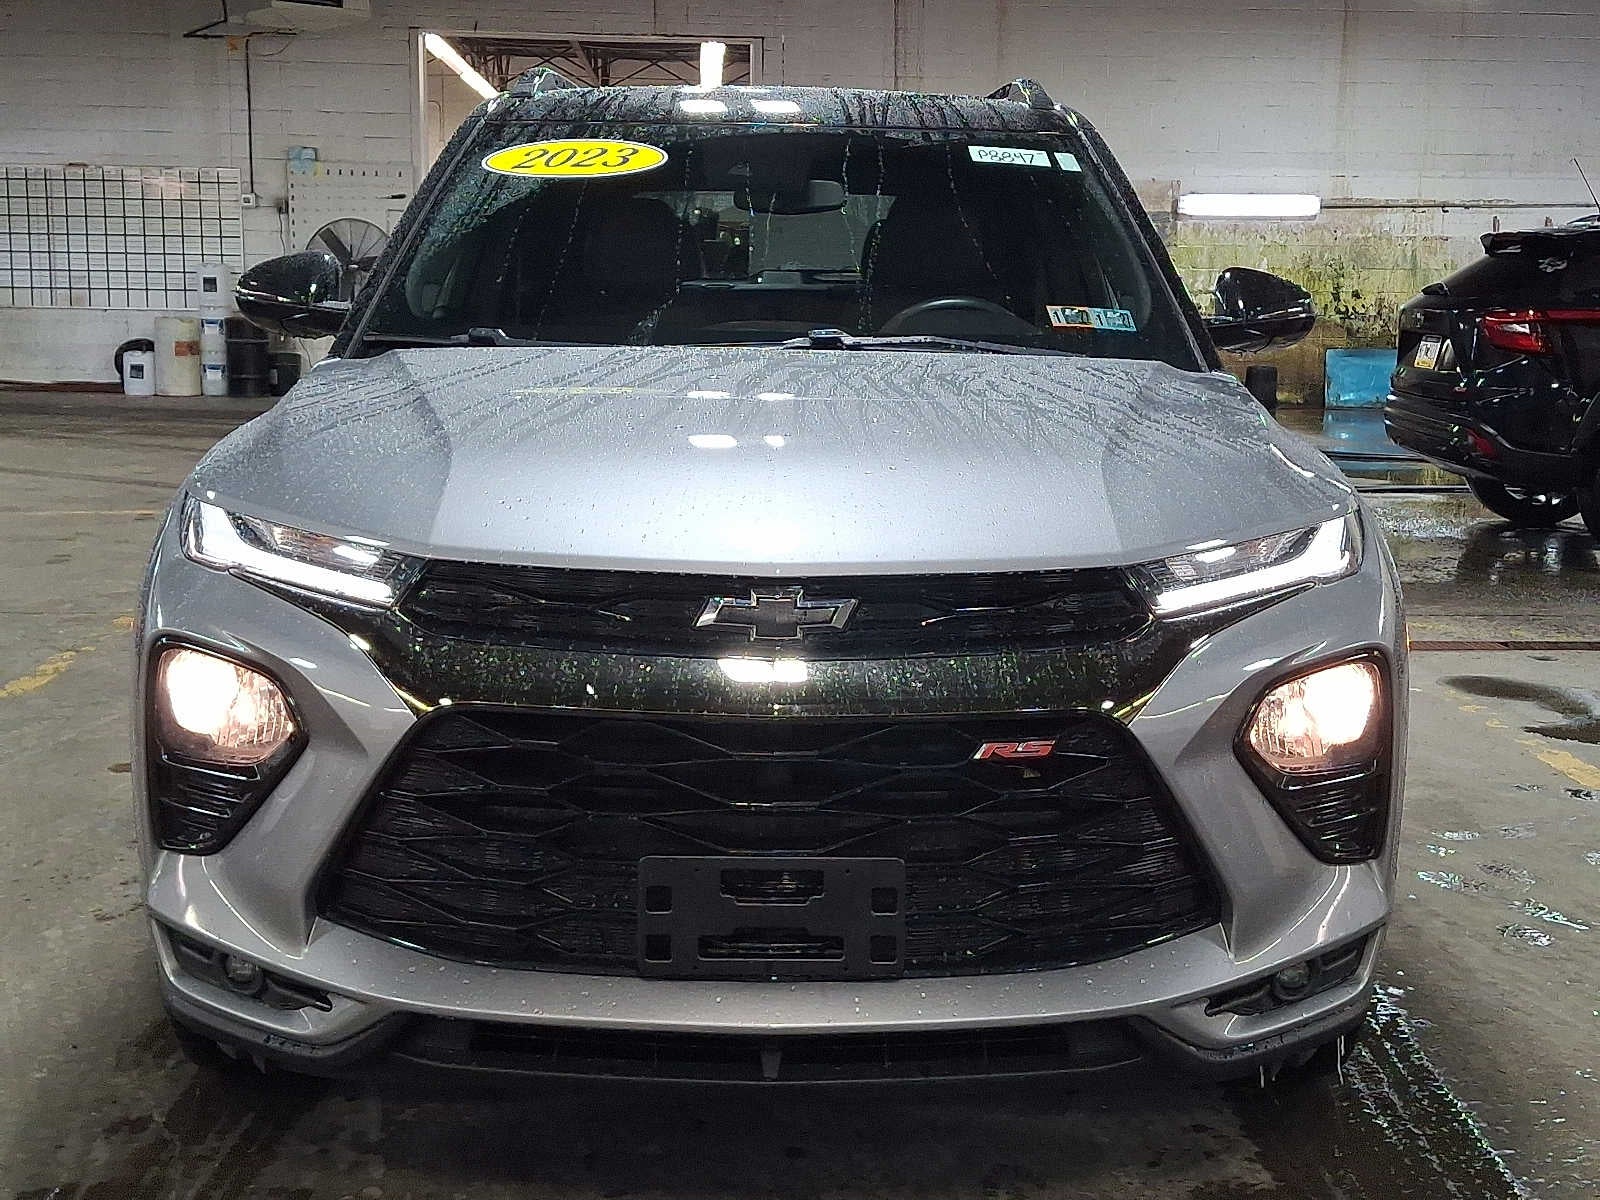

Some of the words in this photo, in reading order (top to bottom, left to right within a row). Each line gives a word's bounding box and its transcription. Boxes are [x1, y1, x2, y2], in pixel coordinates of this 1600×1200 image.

[511, 147, 640, 170] 2023
[977, 149, 1035, 165] P8847
[973, 740, 1056, 759] RS
